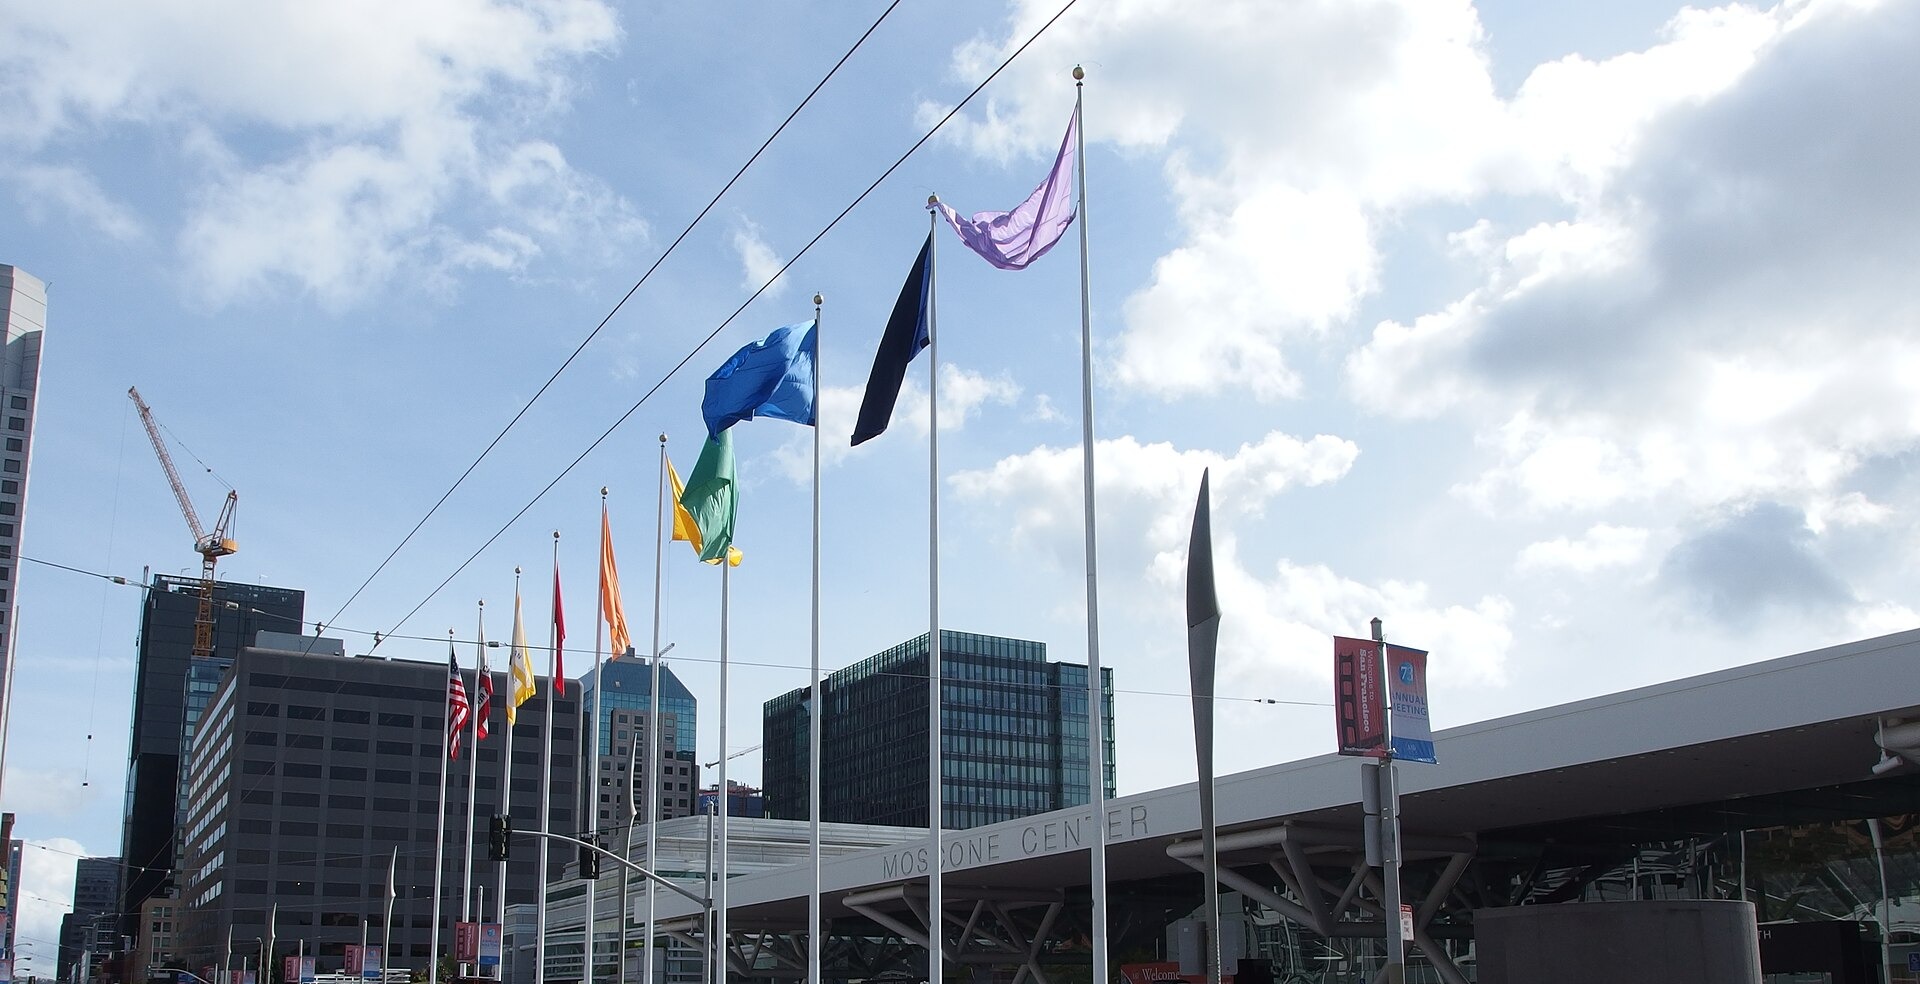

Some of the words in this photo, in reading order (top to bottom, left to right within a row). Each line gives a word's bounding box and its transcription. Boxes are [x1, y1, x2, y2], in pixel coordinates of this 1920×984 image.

[1360, 673, 1370, 733] Francisco
[1369, 691, 1374, 700] to
[1021, 804, 1149, 855] CENER
[1142, 967, 1180, 981] Welcome
